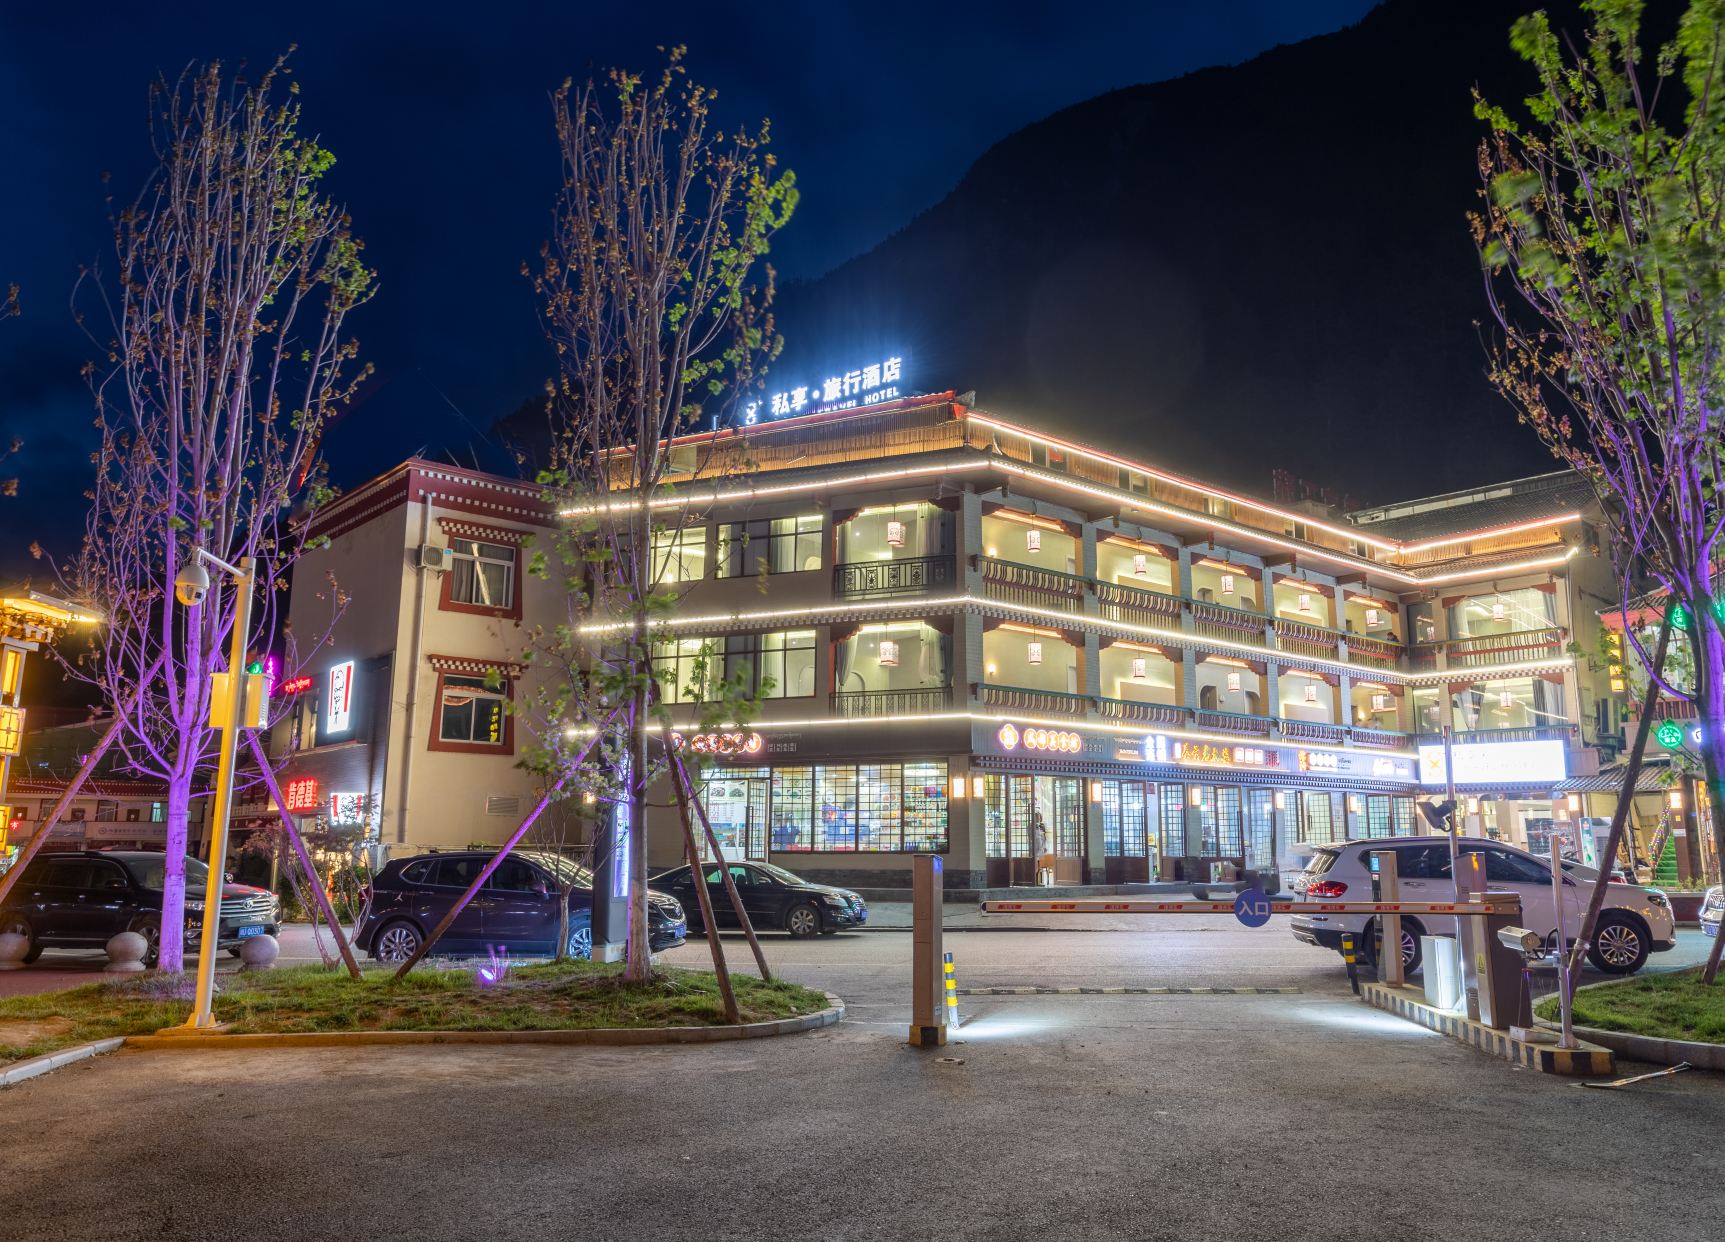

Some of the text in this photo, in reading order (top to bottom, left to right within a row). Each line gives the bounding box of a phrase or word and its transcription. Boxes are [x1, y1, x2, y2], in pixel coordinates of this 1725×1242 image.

[865, 386, 900, 405] HOTEL
[288, 781, 314, 809] 肯德基
[1239, 901, 1269, 916] 入口
